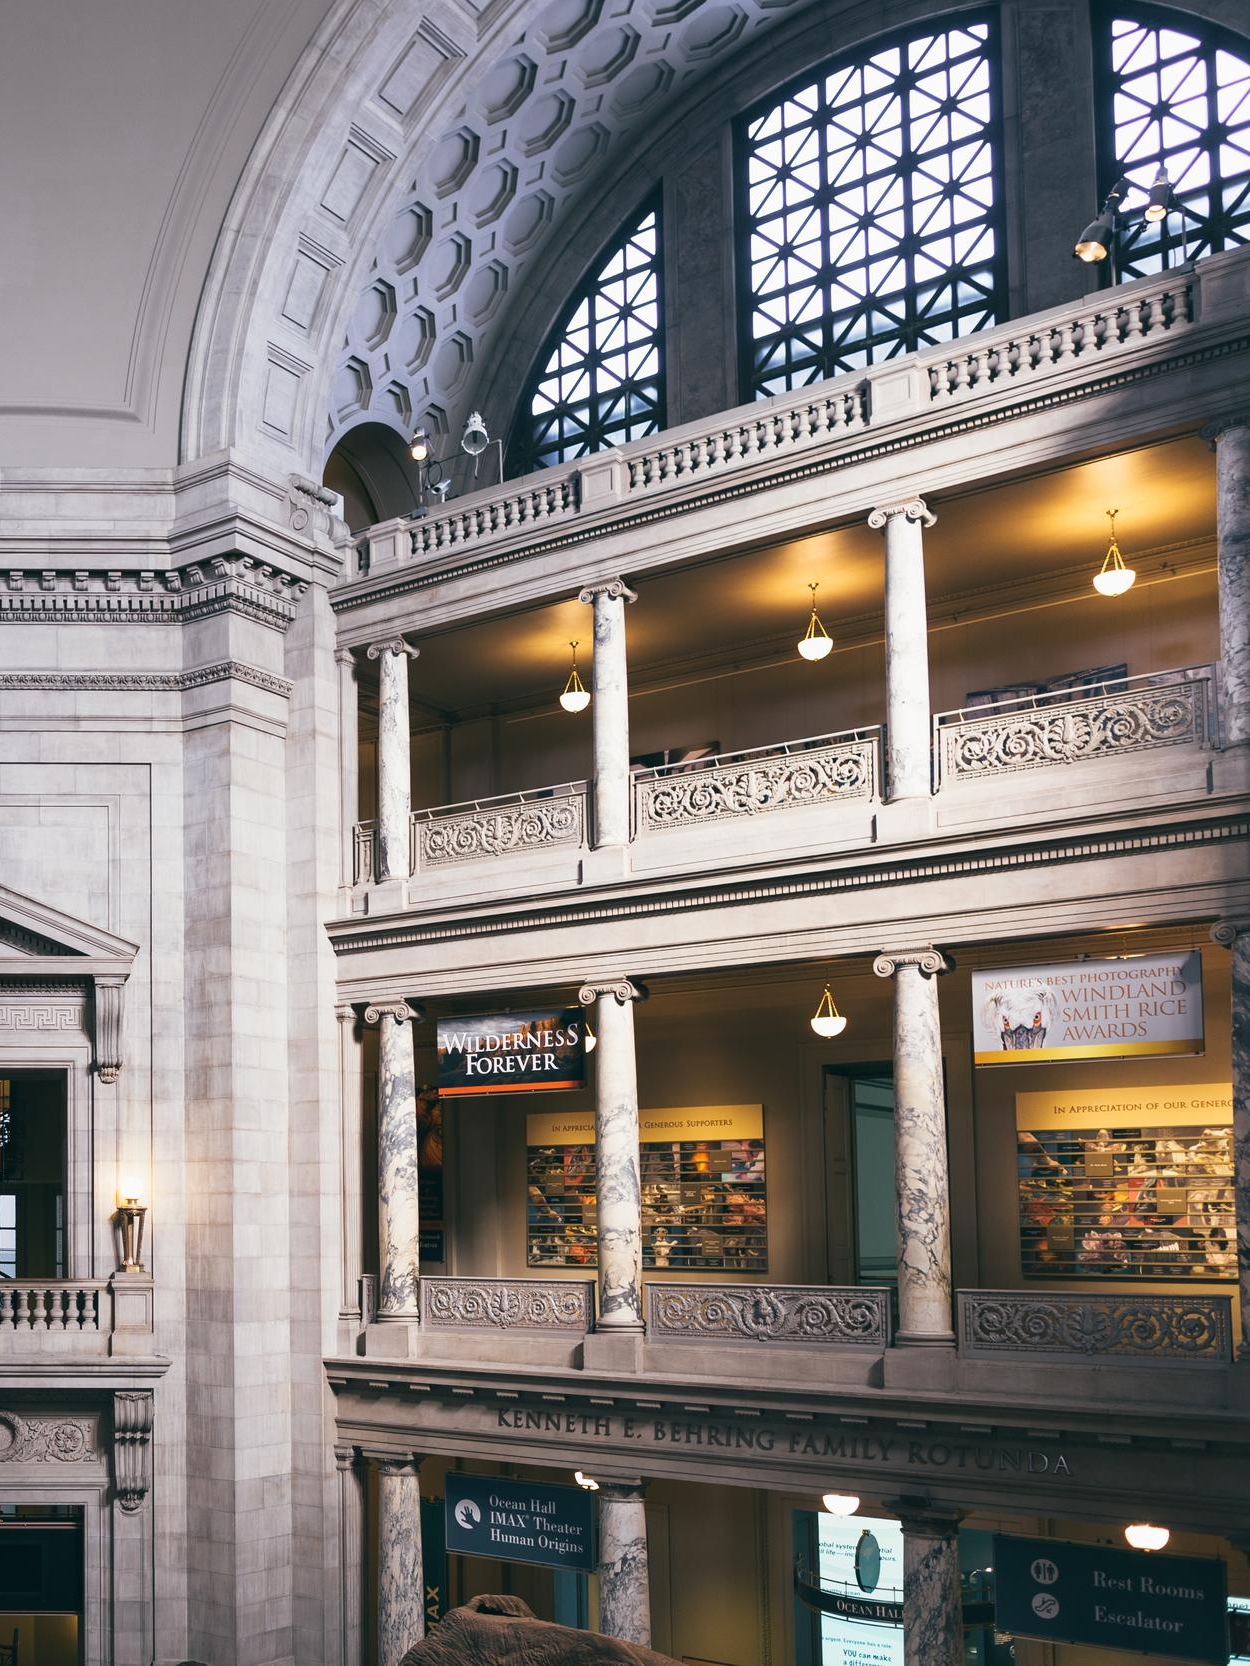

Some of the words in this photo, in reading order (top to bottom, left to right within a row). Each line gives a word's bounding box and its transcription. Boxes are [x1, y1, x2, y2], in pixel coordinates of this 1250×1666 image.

[985, 976, 1042, 991] NATURE'S
[1047, 974, 1074, 986] BEST
[1080, 966, 1184, 983] PHOTOGRAPHY
[1062, 980, 1187, 1004] WINDLAND
[1063, 1004, 1130, 1022] SMITH
[1139, 999, 1188, 1017] RICE
[442, 1023, 579, 1055] WILDERNESS
[1063, 1021, 1148, 1041] AWARDS
[465, 1053, 559, 1075] FOREVER
[1069, 1103, 1142, 1113] APPRECIATION
[644, 1120, 683, 1129] GENEROUS
[686, 1119, 733, 1128] SUPPORTERS
[497, 1408, 611, 1436] KENNETH
[623, 1418, 642, 1439] E.
[653, 1421, 775, 1451] BEHRING
[789, 1432, 895, 1461] FAMILY
[907, 1442, 1072, 1476] ROTUNDA
[490, 1495, 526, 1511] Ocean
[530, 1499, 556, 1514] Hall
[533, 1516, 582, 1535] Theater
[491, 1528, 534, 1546] Human
[538, 1535, 584, 1554] Origins
[1093, 1570, 1132, 1591] Rest
[1140, 1576, 1205, 1599] Rooms
[836, 1600, 873, 1616] OCEAN
[1094, 1605, 1183, 1633] Escalator
[843, 1649, 857, 1658] YOU
